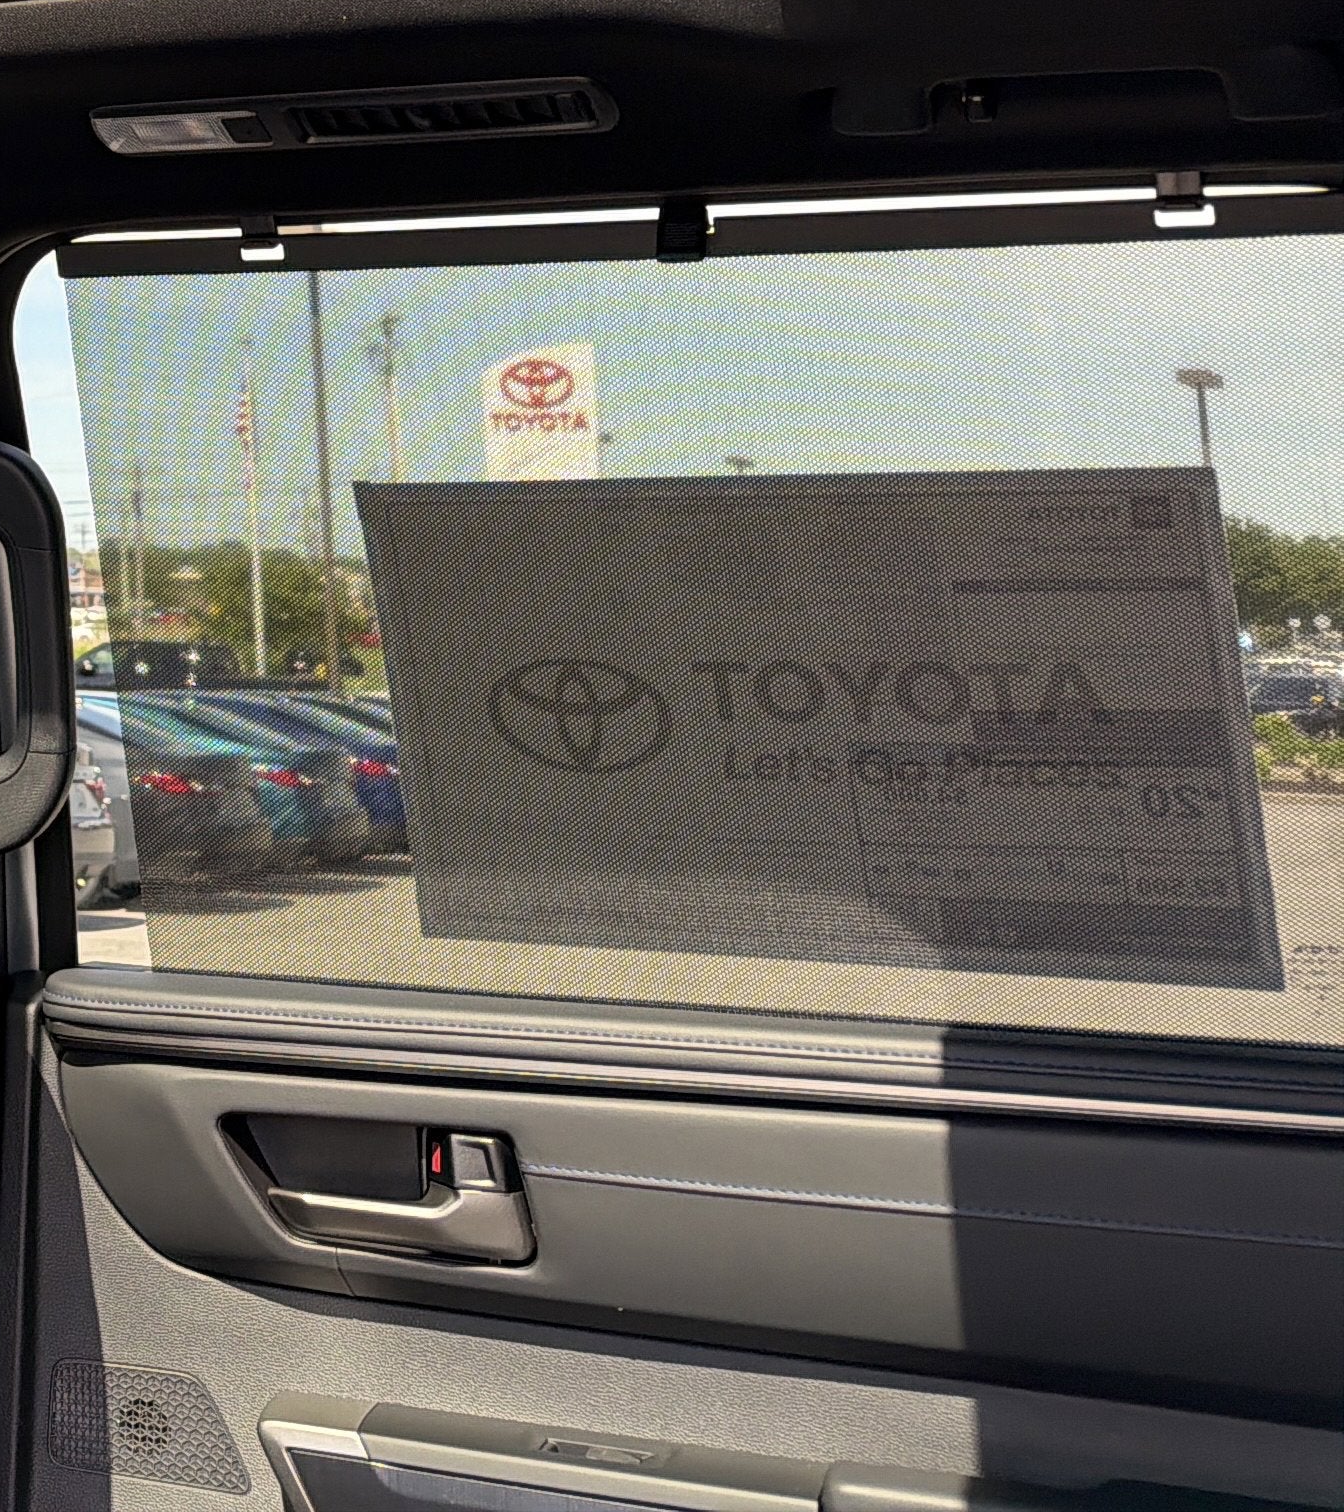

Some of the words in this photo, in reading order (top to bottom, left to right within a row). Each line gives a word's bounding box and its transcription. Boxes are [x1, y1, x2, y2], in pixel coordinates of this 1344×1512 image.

[490, 411, 590, 433] TOYOTA
[691, 660, 1118, 728] TOYOTA
[723, 742, 838, 786] Let's
[857, 748, 929, 787] Go
[944, 746, 1129, 790] Places
